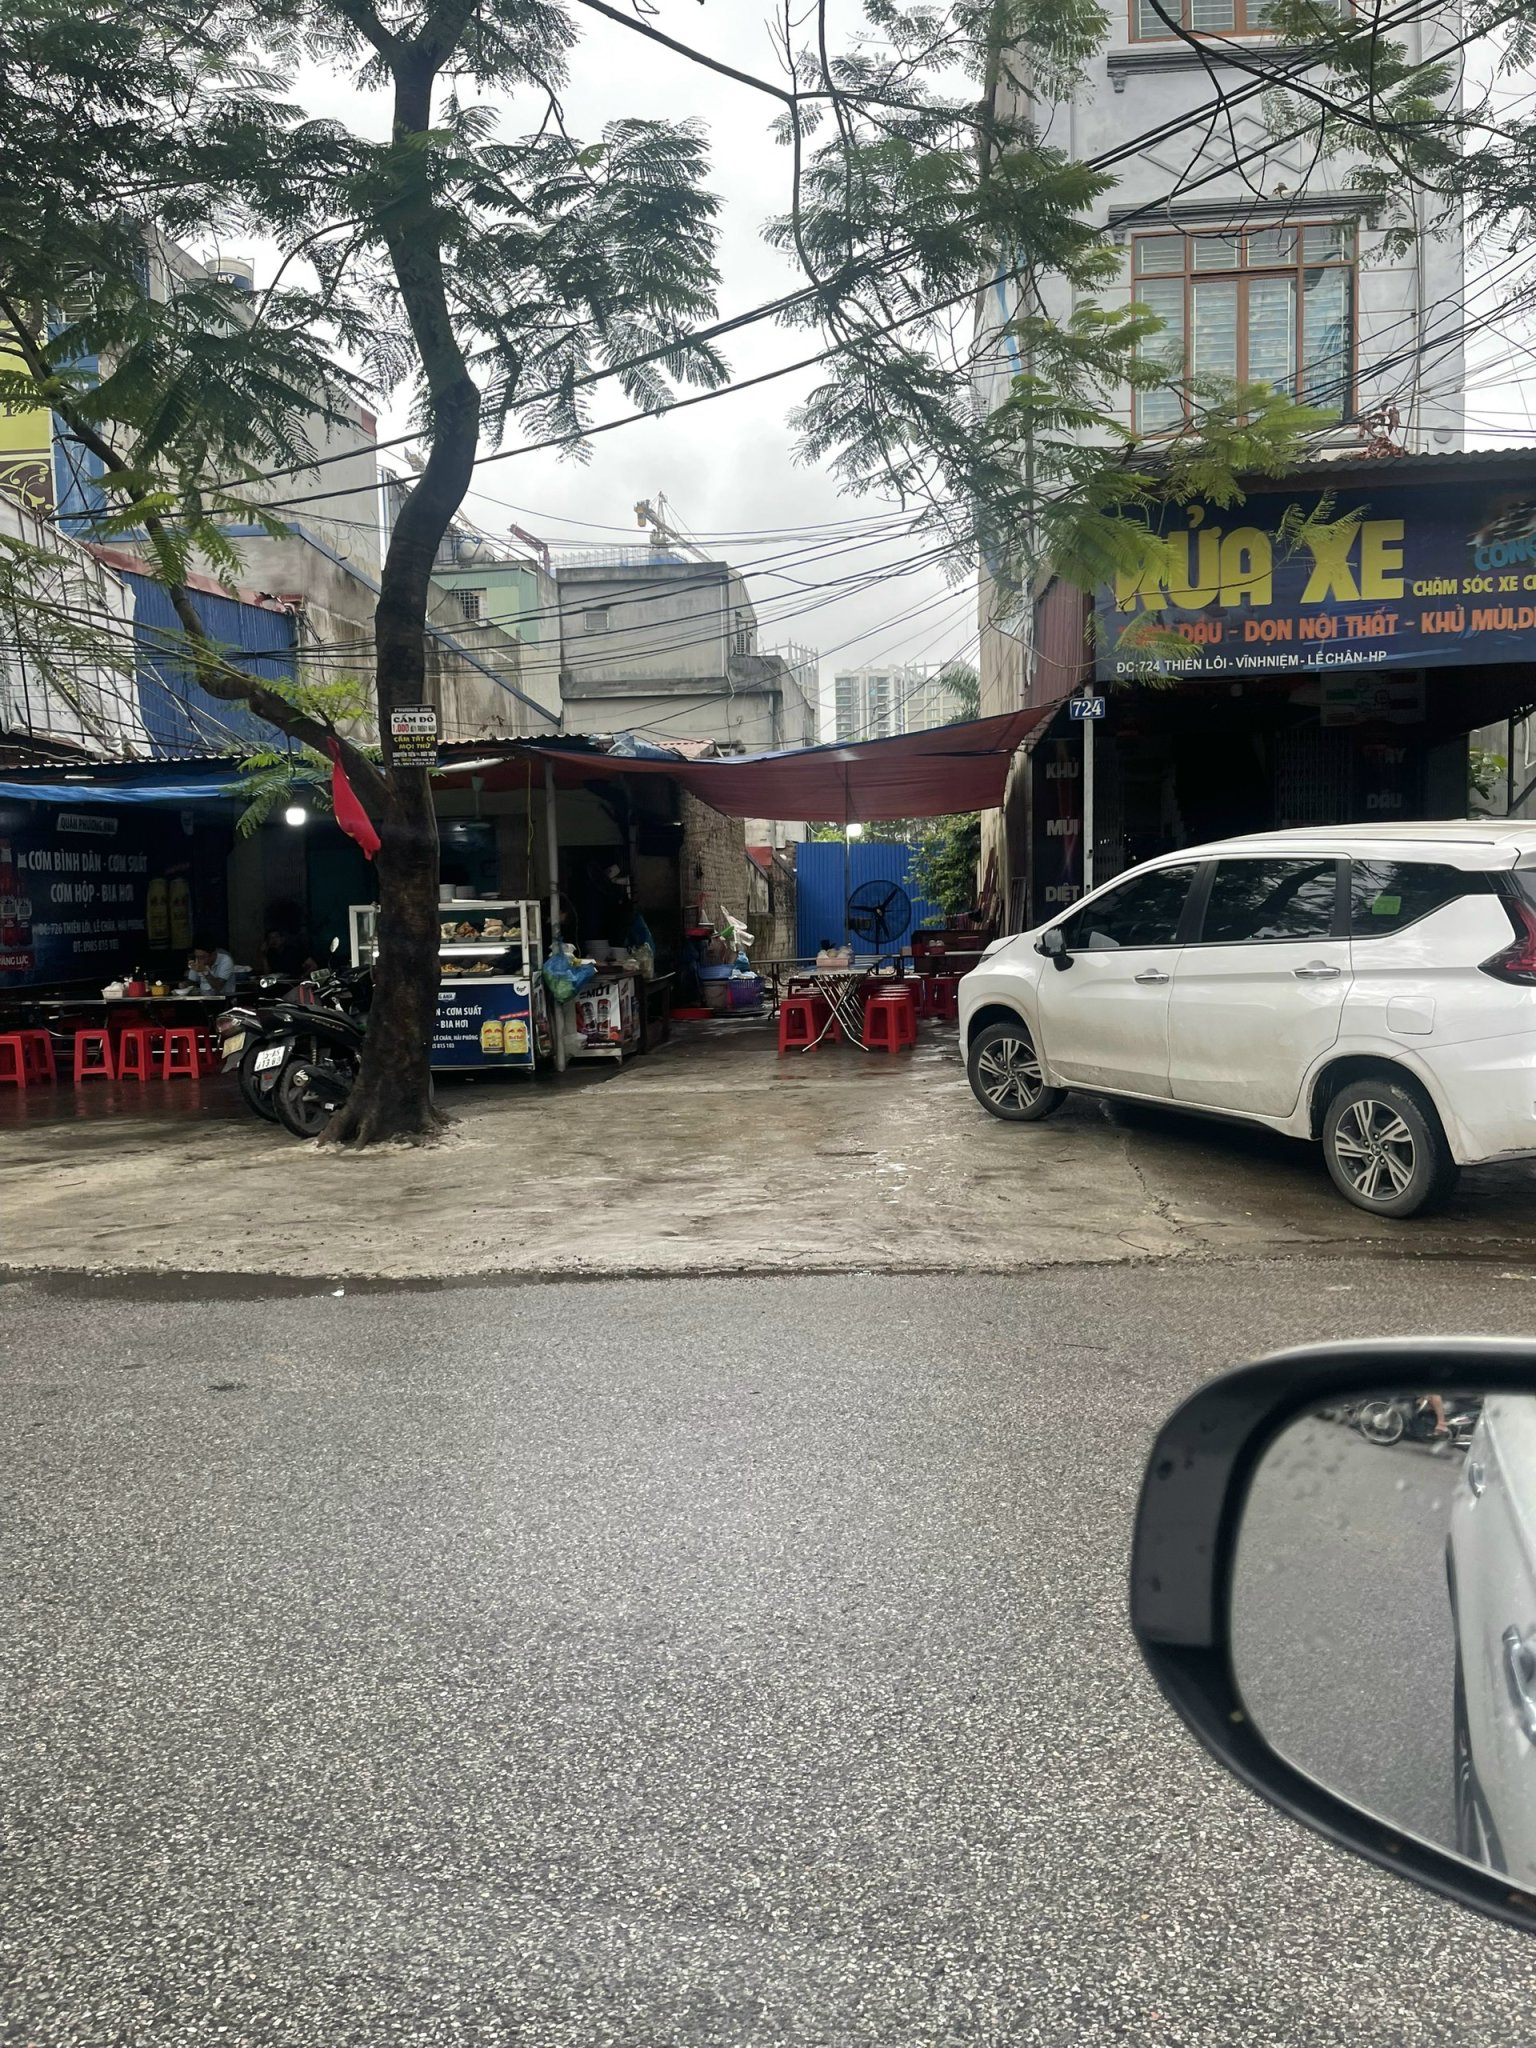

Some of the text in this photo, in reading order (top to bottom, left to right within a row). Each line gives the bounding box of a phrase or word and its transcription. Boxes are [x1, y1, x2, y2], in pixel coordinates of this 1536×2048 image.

[1301, 518, 1405, 603] XE
[1413, 577, 1457, 596] CHĂM
[1462, 574, 1493, 594] SÓC
[1498, 575, 1518, 592] XE
[1244, 619, 1292, 646] DỌN
[1298, 614, 1337, 643] NỘI
[1345, 607, 1399, 638] THẤT
[1165, 656, 1204, 671] THIÊN
[1206, 655, 1227, 669] LÔI
[1073, 700, 1103, 717] 724
[1046, 816, 1080, 837] MÙI
[28, 849, 52, 870] CƠM
[54, 848, 79, 871] BÌNH
[82, 850, 101, 872] DÂN
[108, 853, 127, 872] CƠM
[50, 882, 73, 903] CƠM
[75, 880, 95, 908] HỘP
[101, 884, 117, 902] BIA
[1045, 881, 1081, 906] DIỆT
[446, 1007, 462, 1016] CƠM
[463, 1004, 482, 1016] SUẤT
[440, 1020, 454, 1028] BIA
[455, 1019, 468, 1028] HƠI
